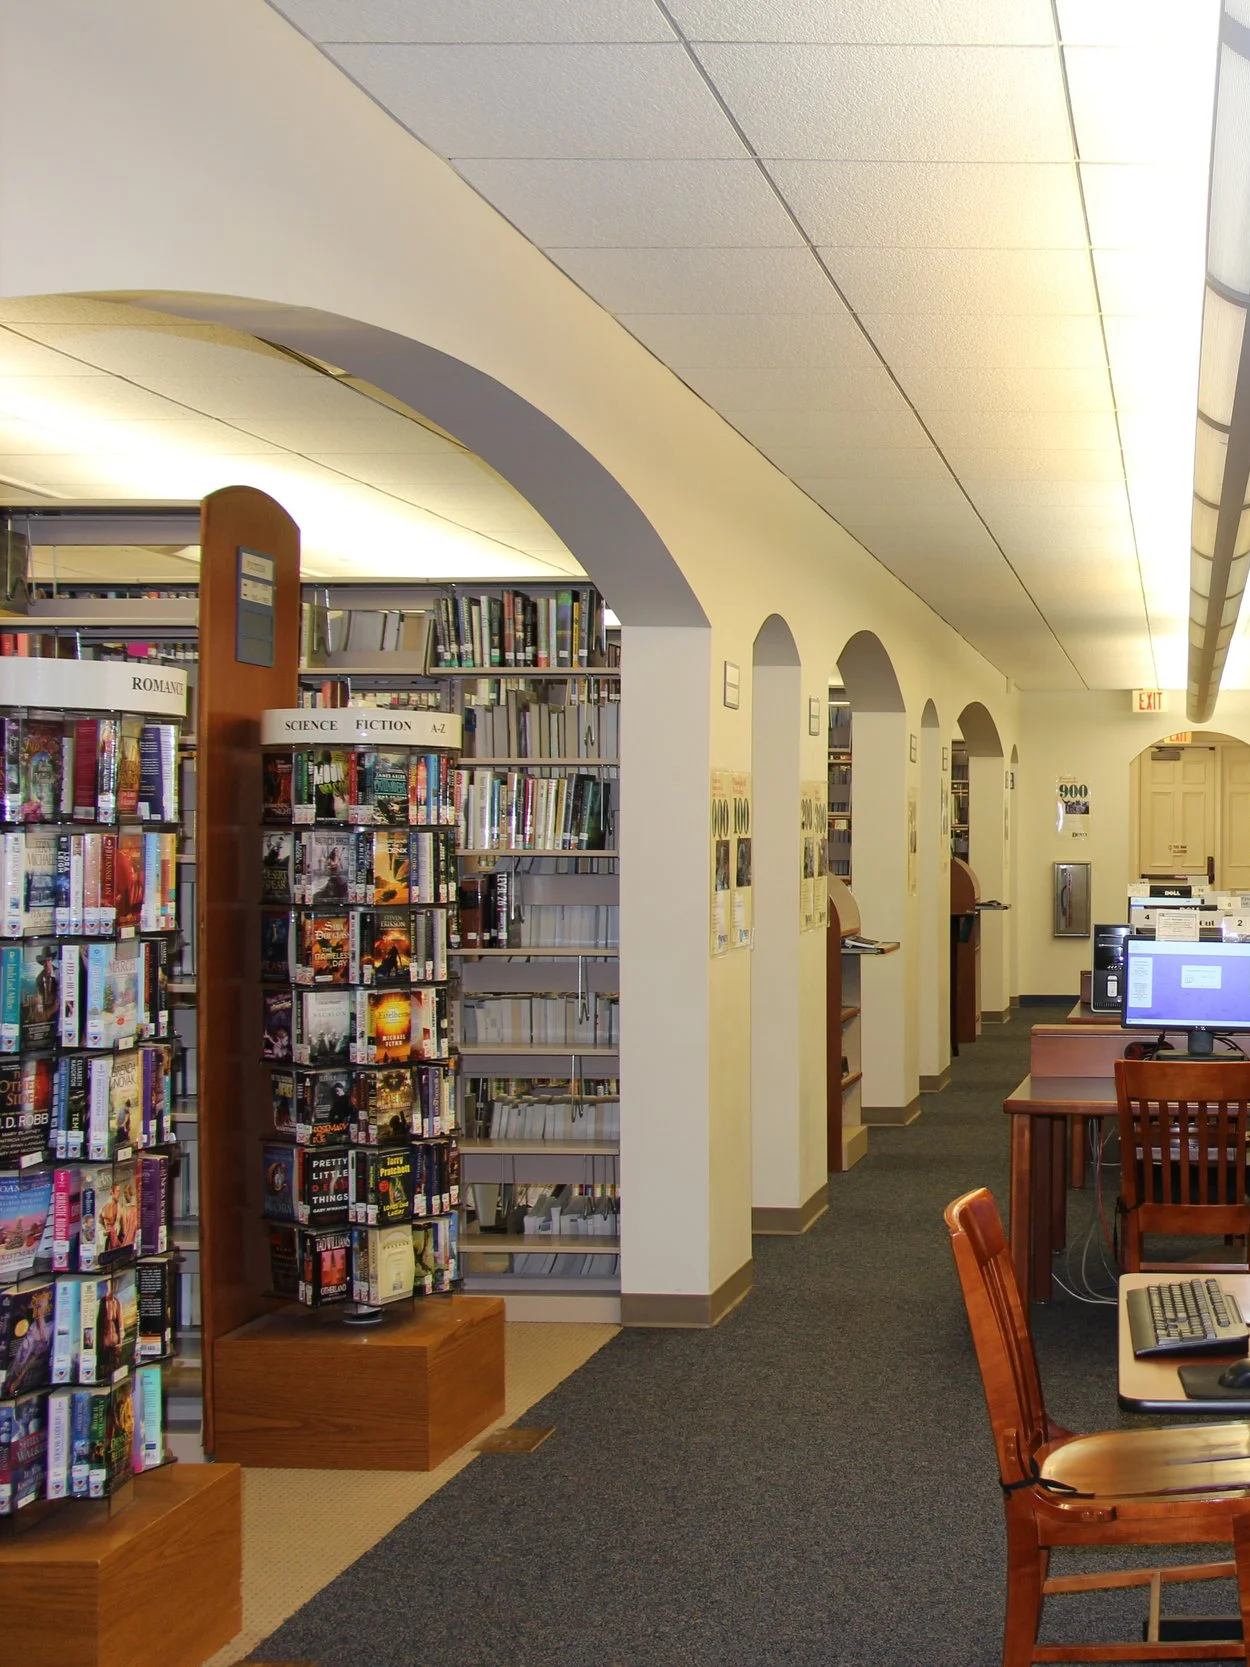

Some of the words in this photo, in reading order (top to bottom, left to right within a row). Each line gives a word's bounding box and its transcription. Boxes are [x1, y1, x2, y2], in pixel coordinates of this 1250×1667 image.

[132, 676, 184, 696] ROMANCE
[1139, 692, 1163, 710] EXIT
[285, 720, 338, 731] SCIENCE
[355, 719, 412, 731] FICTION
[431, 723, 446, 733] A-Z
[1059, 784, 1088, 798] 900
[712, 799, 729, 837] 000
[733, 797, 750, 835] 100
[380, 920, 407, 928] ERIKSON
[7, 963, 17, 978] Linda
[108, 959, 136, 973] MARCH
[382, 1034, 406, 1042] MICHAEL
[6, 1117, 17, 1128] D.
[19, 1114, 49, 1127] ROBB
[312, 1157, 347, 1168] PRETTY
[387, 1156, 404, 1165] Terry
[312, 1169, 350, 1180] LITTLE
[379, 1164, 411, 1177] Pratchett
[56, 1192, 68, 1217] CHRISTIE
[312, 1194, 349, 1204] THINGS
[56, 1219, 67, 1241] RIDGWA
[316, 1237, 329, 1251] TAD
[327, 1232, 351, 1250] WILLIAMS
[320, 1284, 347, 1295] OTHERLAND
